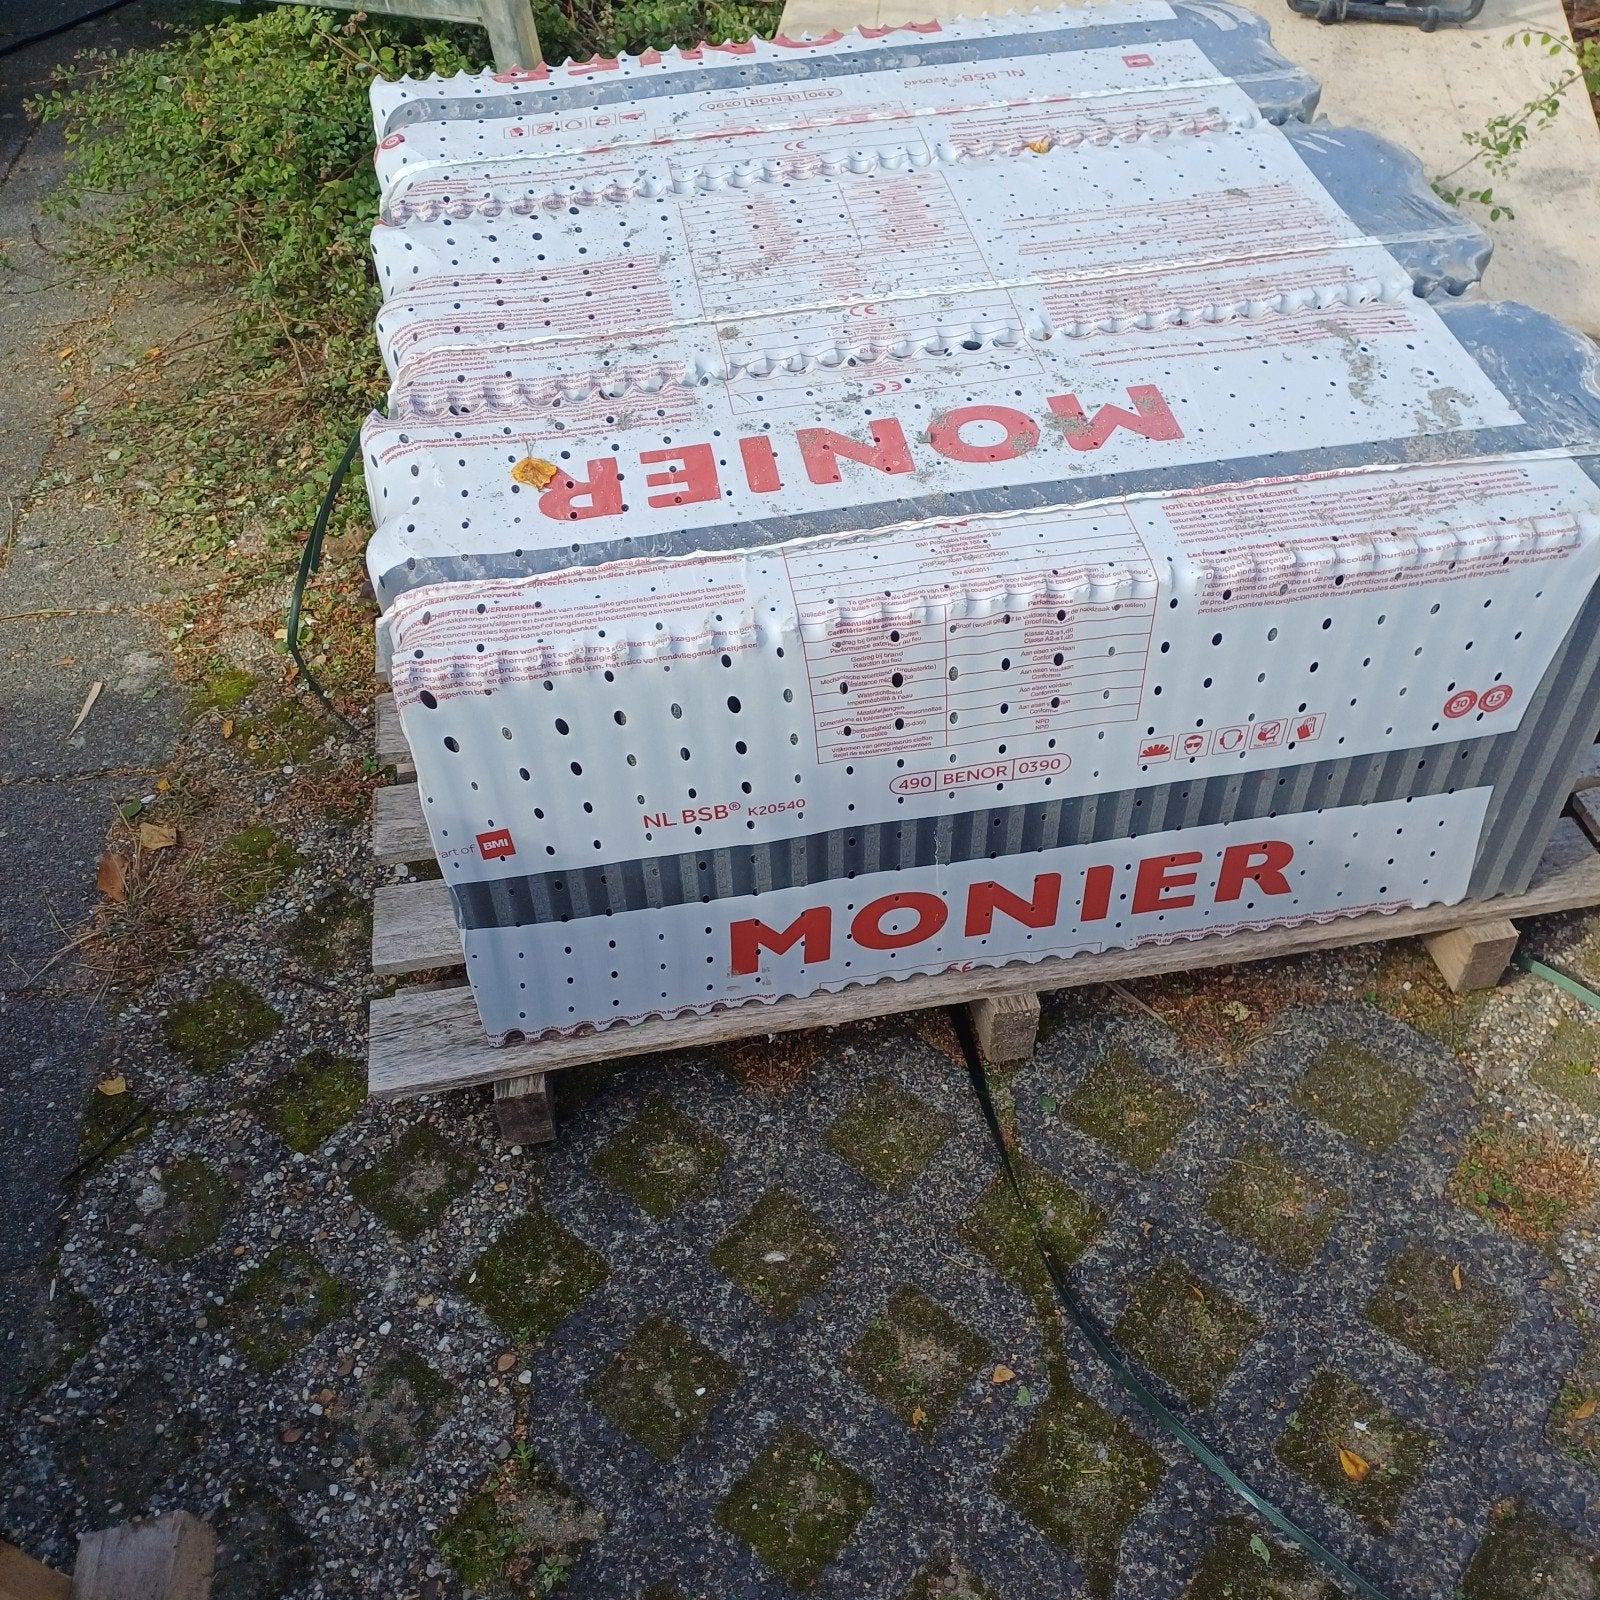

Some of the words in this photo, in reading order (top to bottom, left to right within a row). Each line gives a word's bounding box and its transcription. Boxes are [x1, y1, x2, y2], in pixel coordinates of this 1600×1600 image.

[539, 385, 1184, 520] MONIER
[568, 575, 597, 585] komen
[638, 565, 668, 576] pannen
[489, 612, 520, 621] worden
[575, 610, 594, 618] deze
[638, 602, 658, 610] komt
[899, 775, 931, 790] 490
[943, 765, 1008, 785] BENOR
[1019, 757, 1061, 775] 0390
[643, 812, 677, 829] NL
[748, 799, 806, 817] K20540
[438, 848, 459, 859] art
[483, 838, 509, 851] BMI
[730, 840, 1294, 977] MONIER
